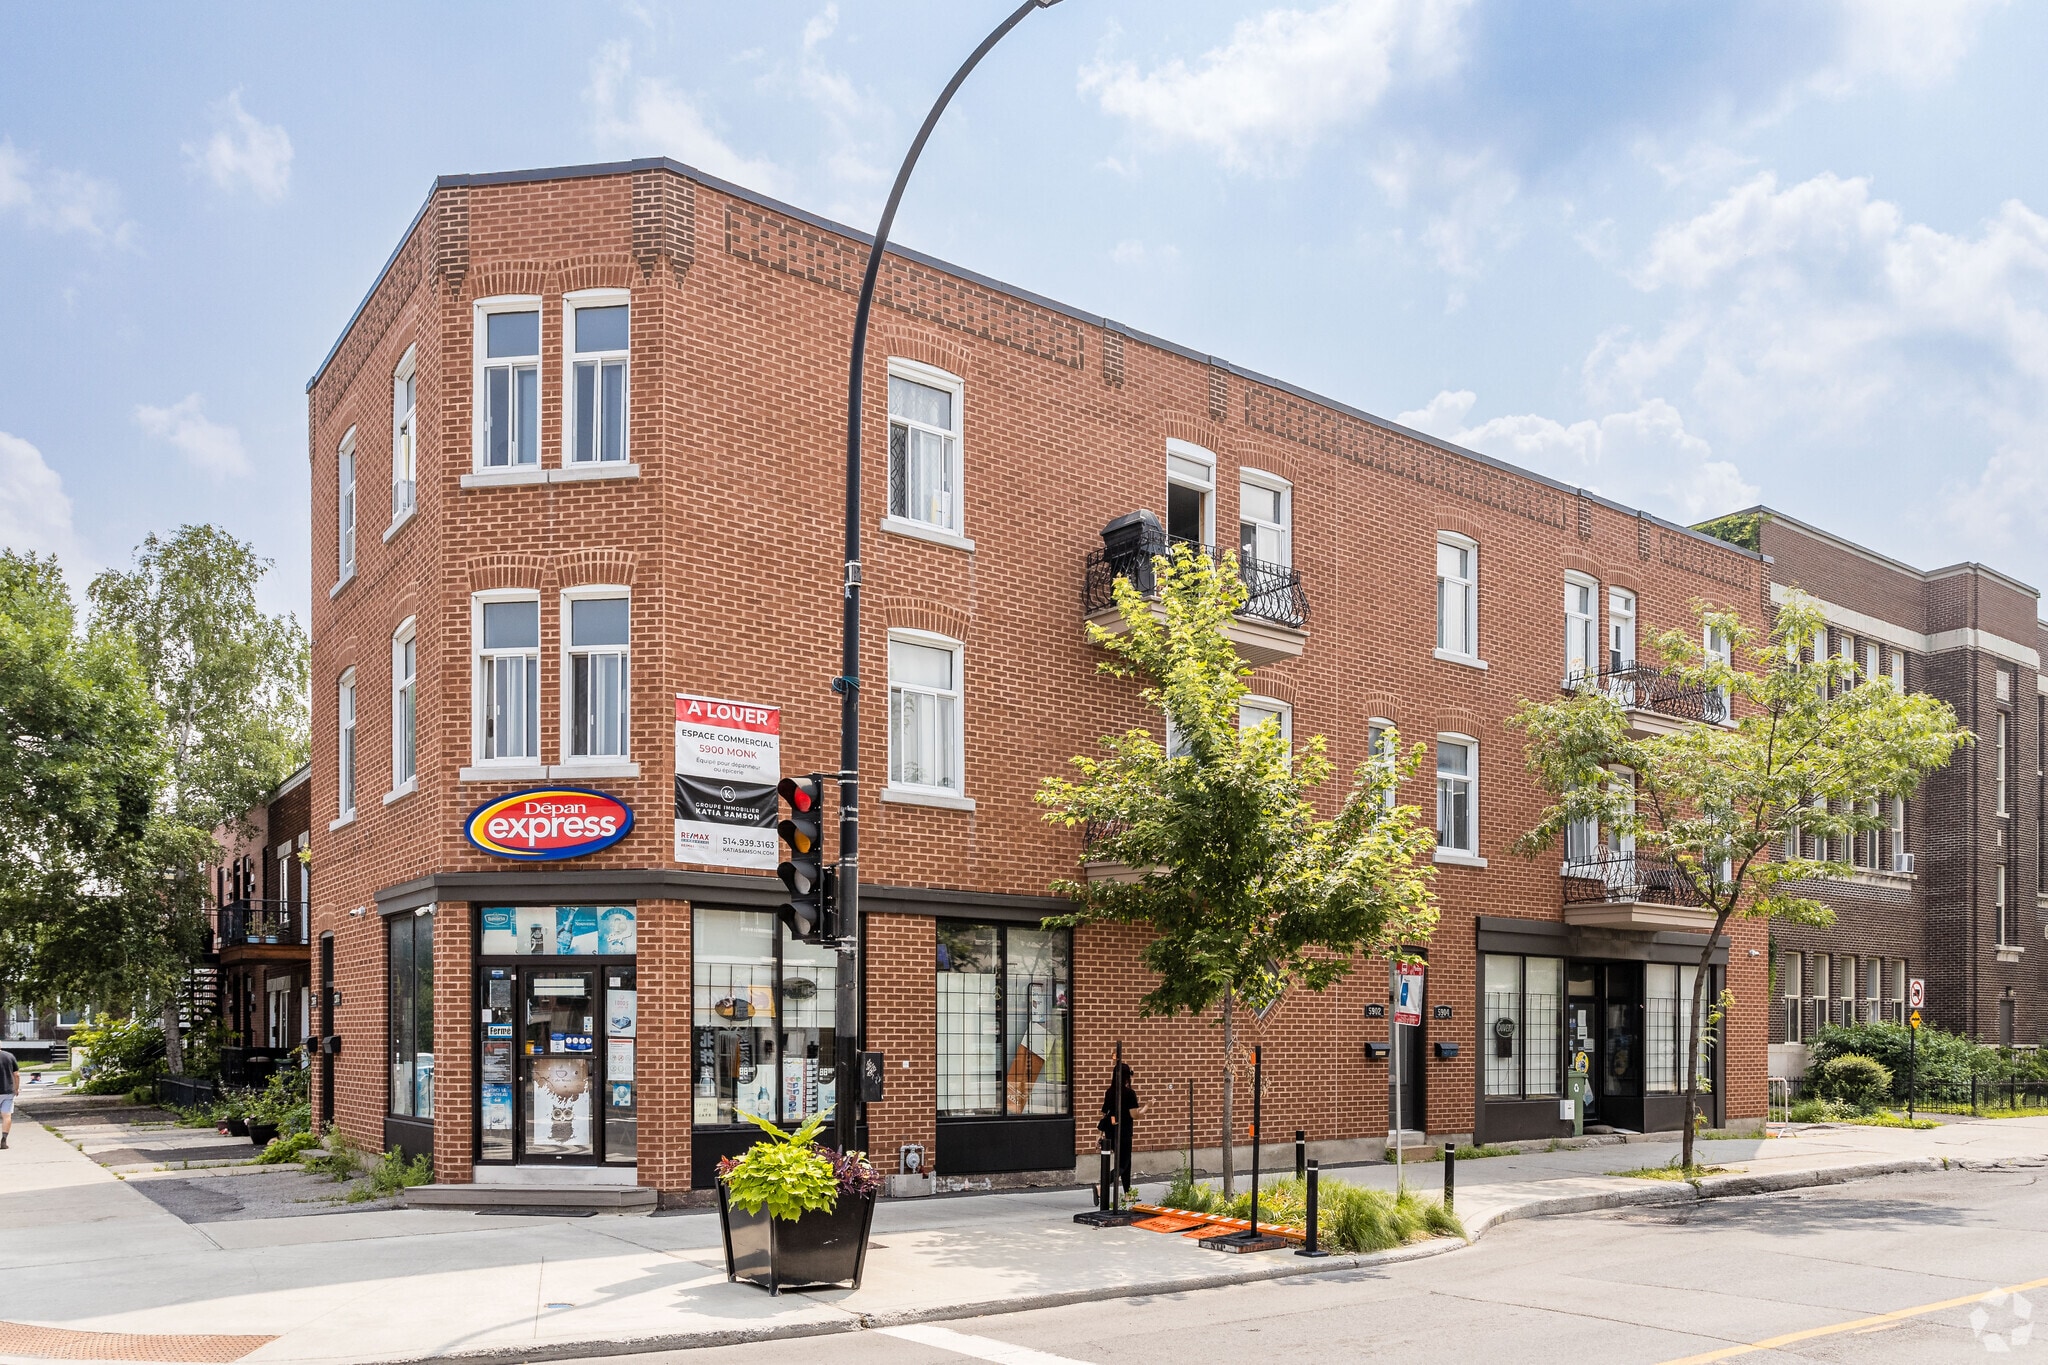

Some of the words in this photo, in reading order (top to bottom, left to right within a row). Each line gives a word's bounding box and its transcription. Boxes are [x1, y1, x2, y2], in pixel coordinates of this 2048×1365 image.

[706, 702, 769, 726] LOUER
[681, 729, 715, 741] ESPACE
[717, 734, 774, 749] COMMERCIAL
[699, 744, 724, 755] 5900
[726, 747, 758, 760] MONK
[524, 802, 587, 818] Dépan
[695, 801, 721, 810] GROUPE
[723, 804, 760, 814] IMMOBILIER
[695, 807, 721, 817] KATIA
[724, 810, 760, 821] SAMSON
[487, 815, 617, 848] express
[680, 831, 710, 841] RE/MAX
[722, 837, 775, 849] 514.939.3163
[722, 847, 775, 856] KATIASAMSON.COM
[1368, 1007, 1382, 1016] 5902
[1437, 1008, 1450, 1017] 5904
